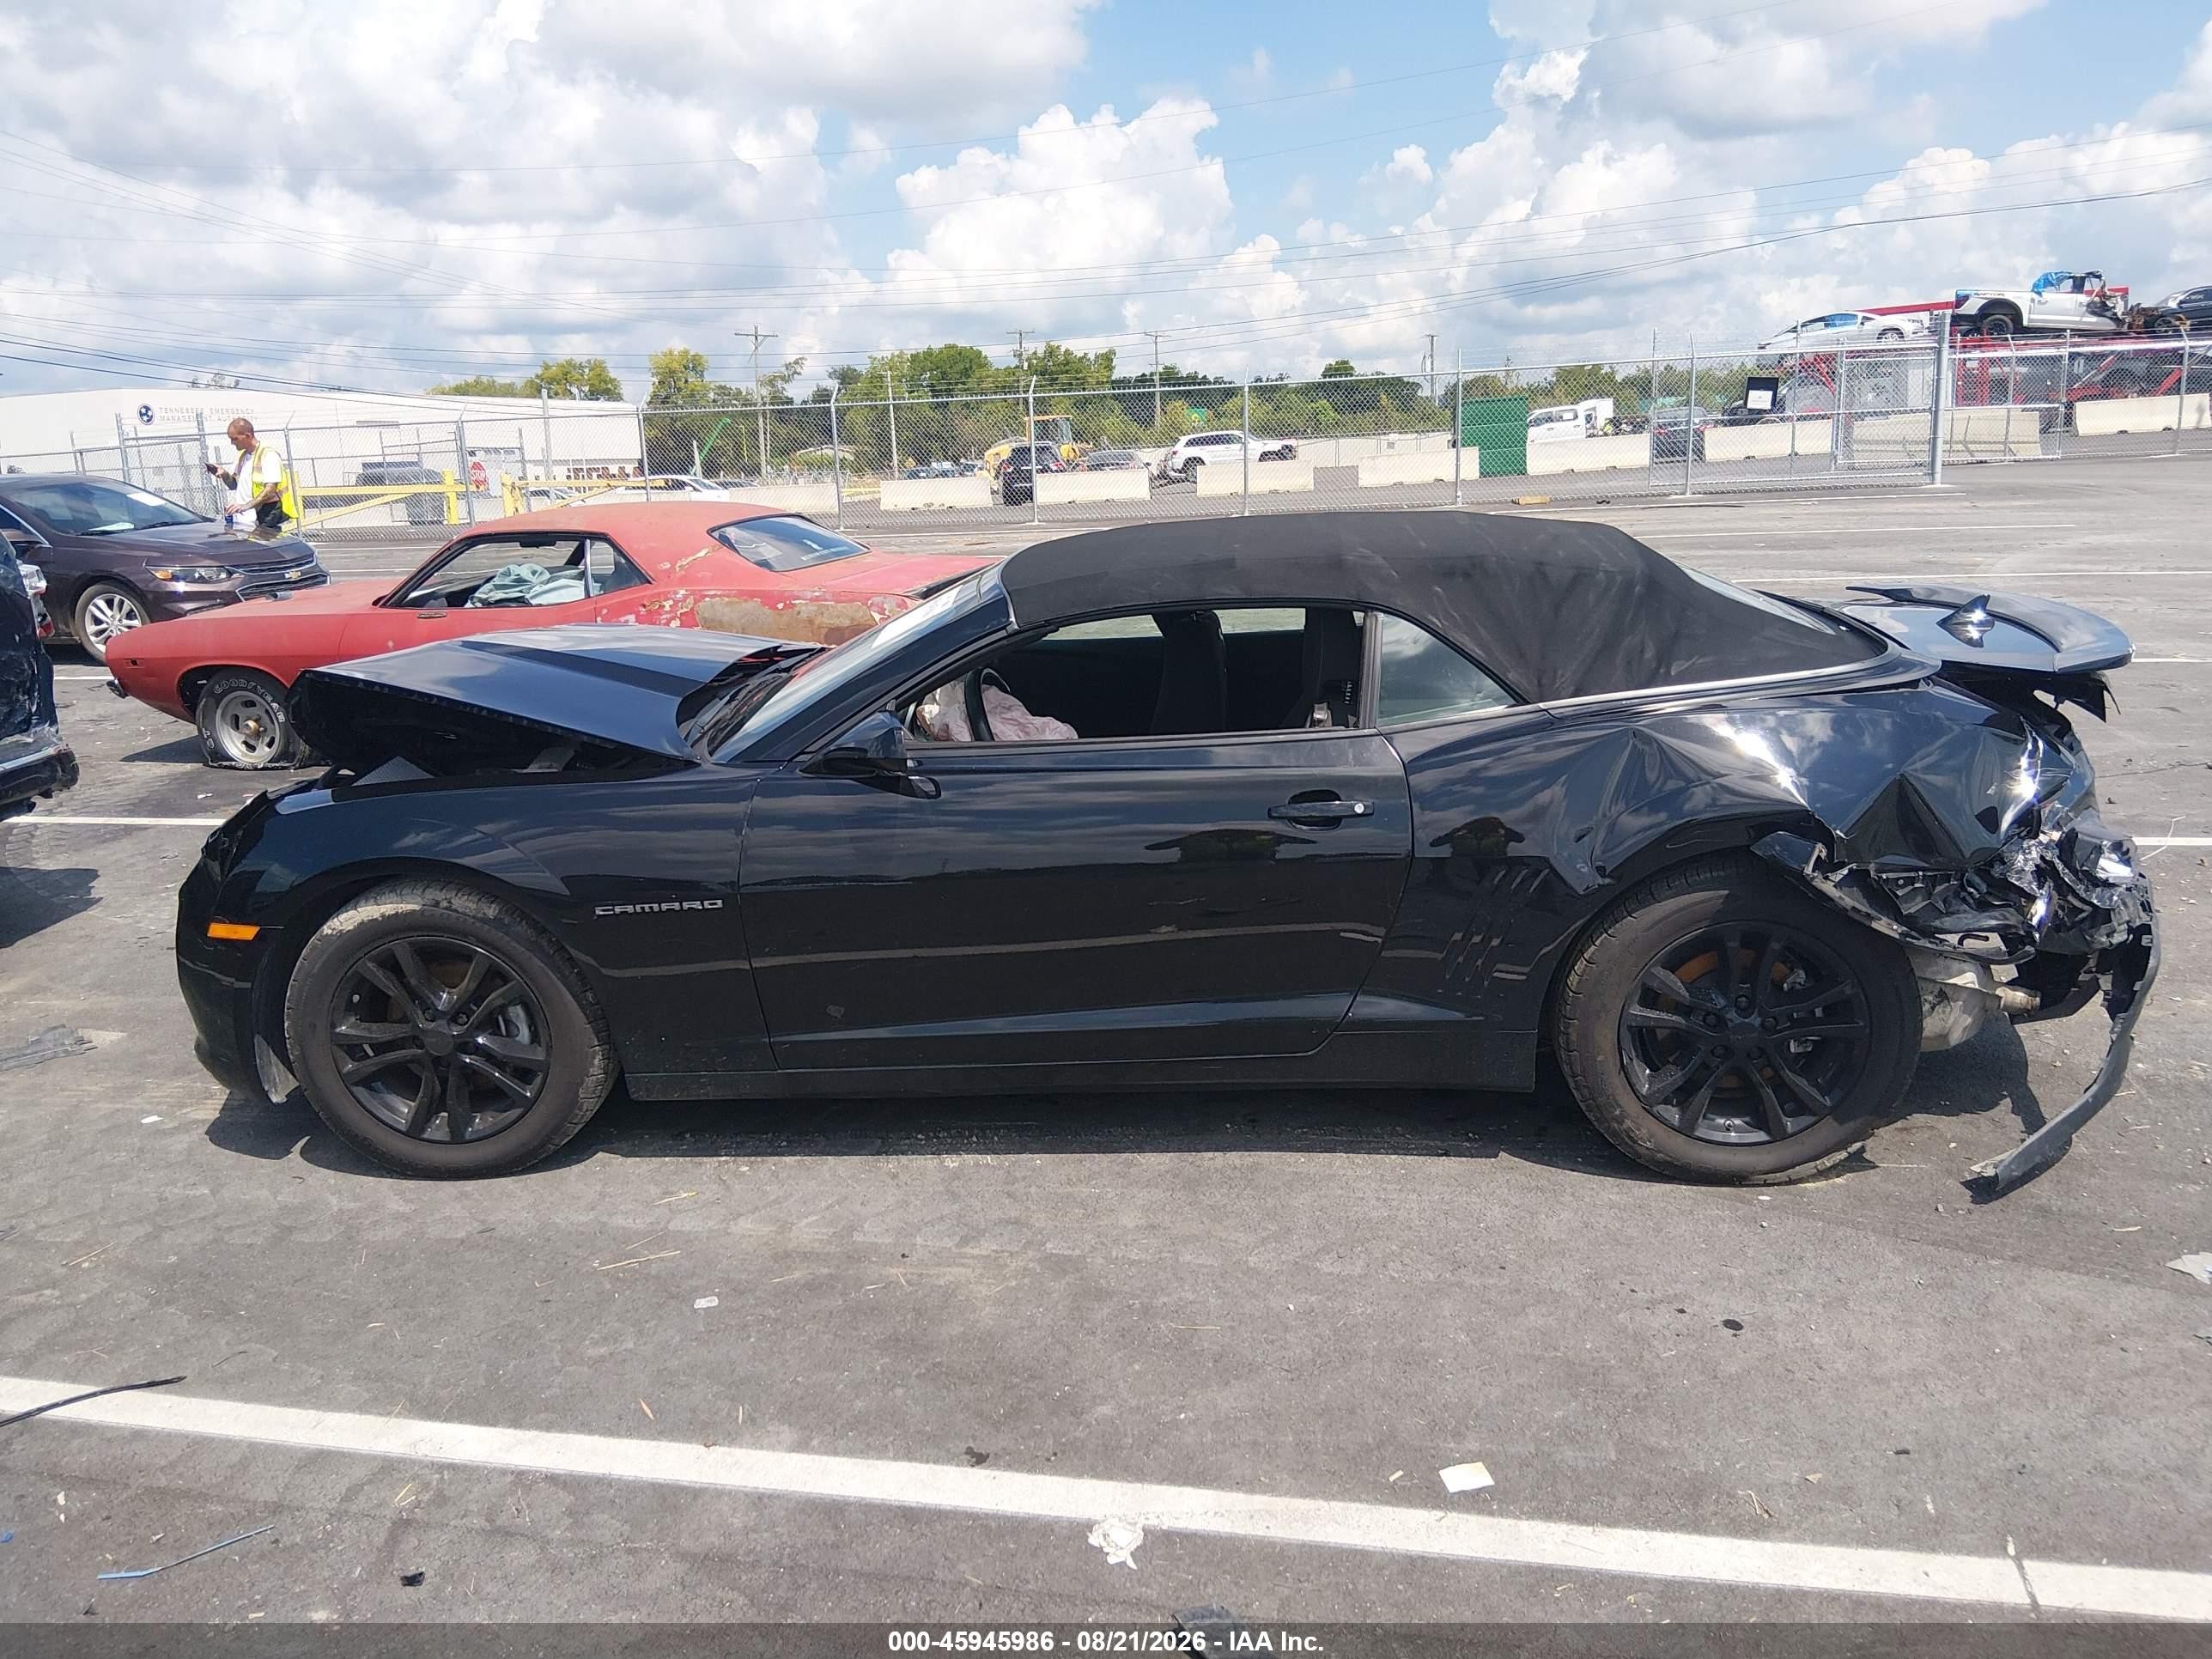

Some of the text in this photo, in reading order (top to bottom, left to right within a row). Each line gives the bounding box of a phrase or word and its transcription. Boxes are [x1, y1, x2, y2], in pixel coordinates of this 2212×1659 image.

[471, 470, 486, 481] STOP
[213, 678, 285, 722] GOODYEAR
[594, 899, 723, 915] CAMARO
